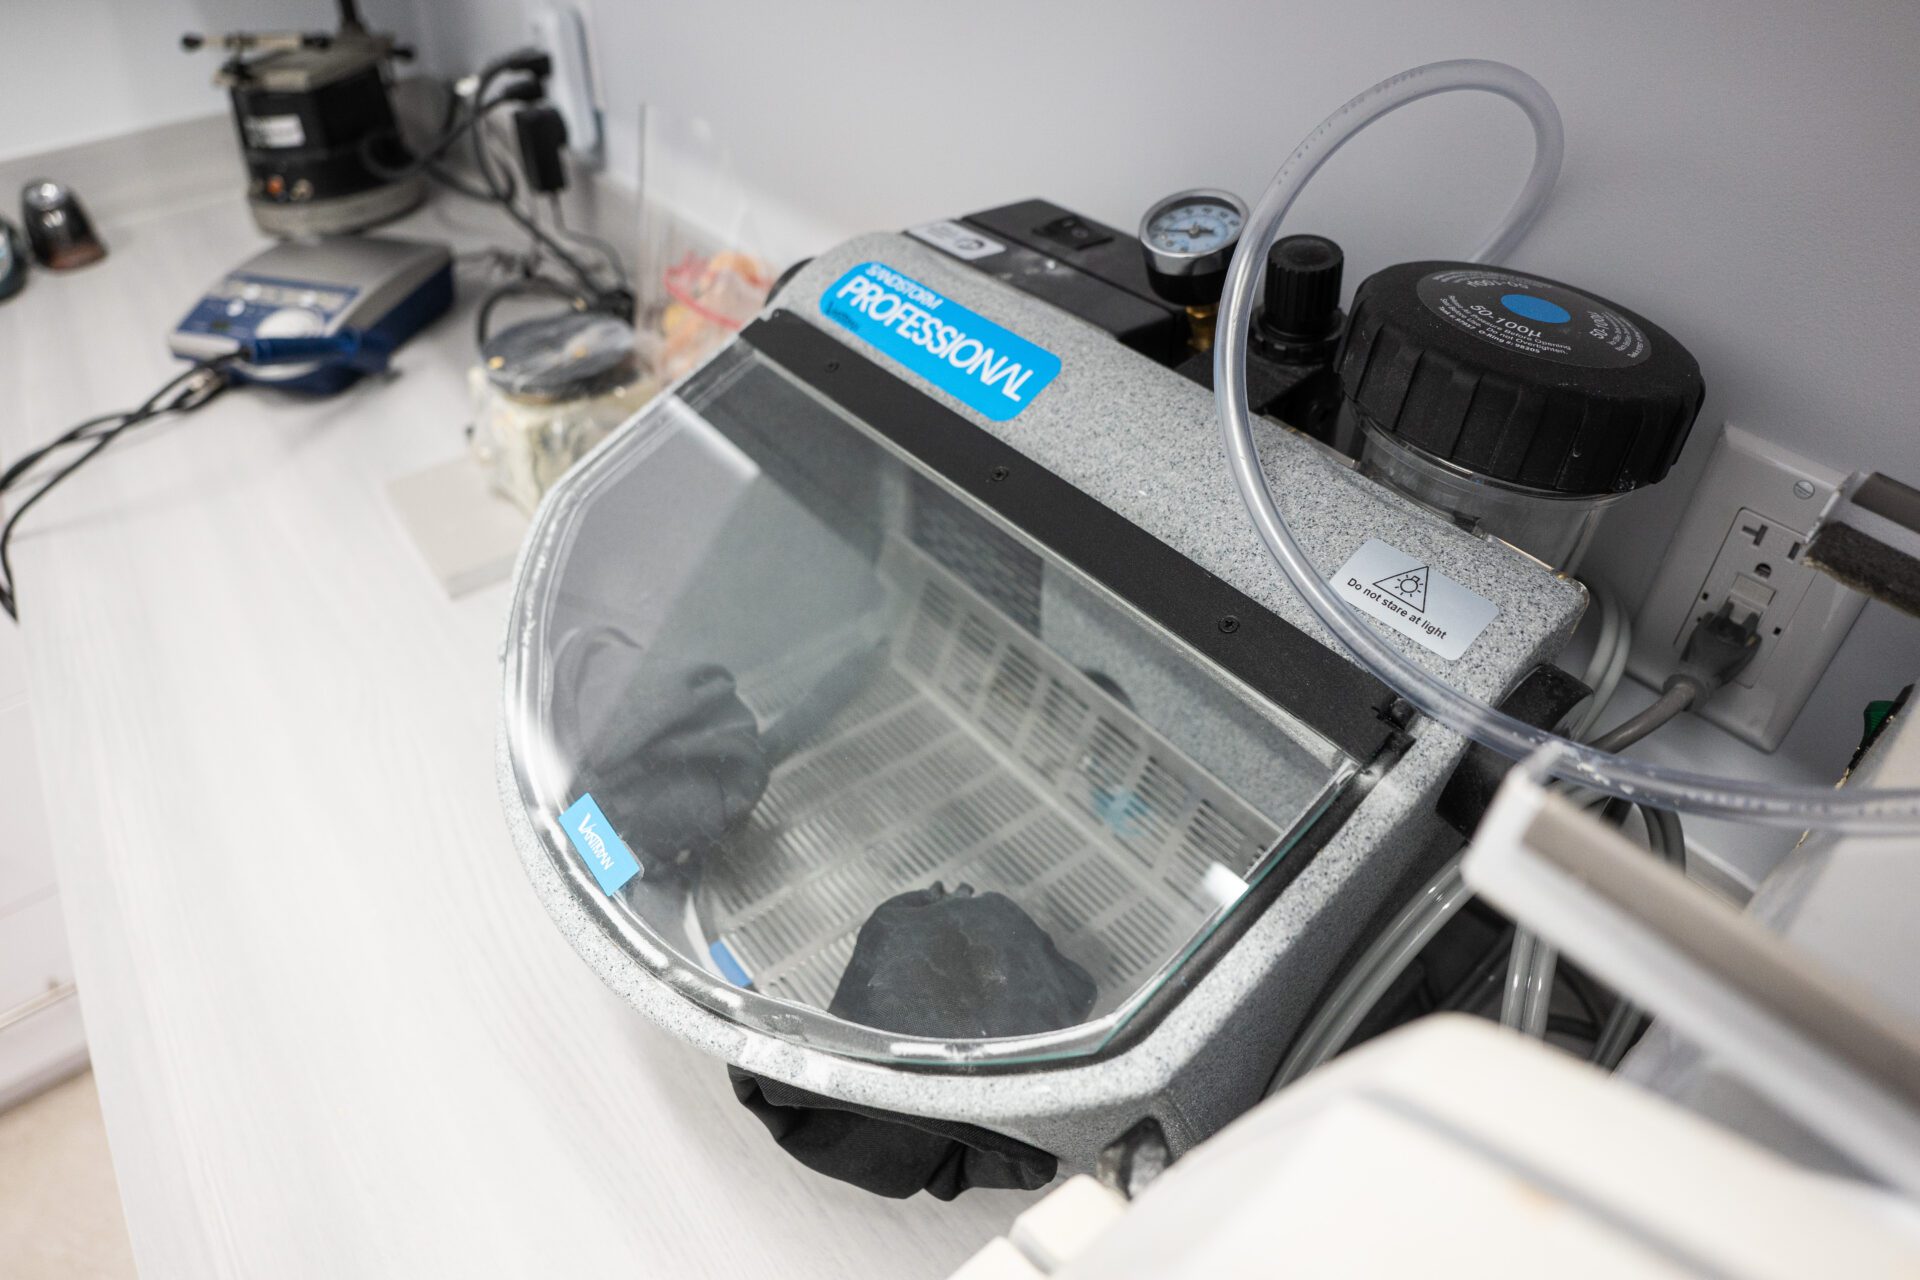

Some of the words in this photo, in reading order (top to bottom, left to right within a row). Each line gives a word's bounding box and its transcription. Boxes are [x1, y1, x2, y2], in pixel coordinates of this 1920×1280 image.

[836, 275, 1034, 402] PROFESSIONAL
[1500, 333, 1514, 341] not
[1504, 329, 1533, 341] Before
[1534, 338, 1572, 351] Opening
[1347, 577, 1362, 591] Do
[1363, 588, 1382, 603] not
[1381, 597, 1408, 618] stare
[1408, 614, 1421, 626] at
[1421, 619, 1448, 640] light
